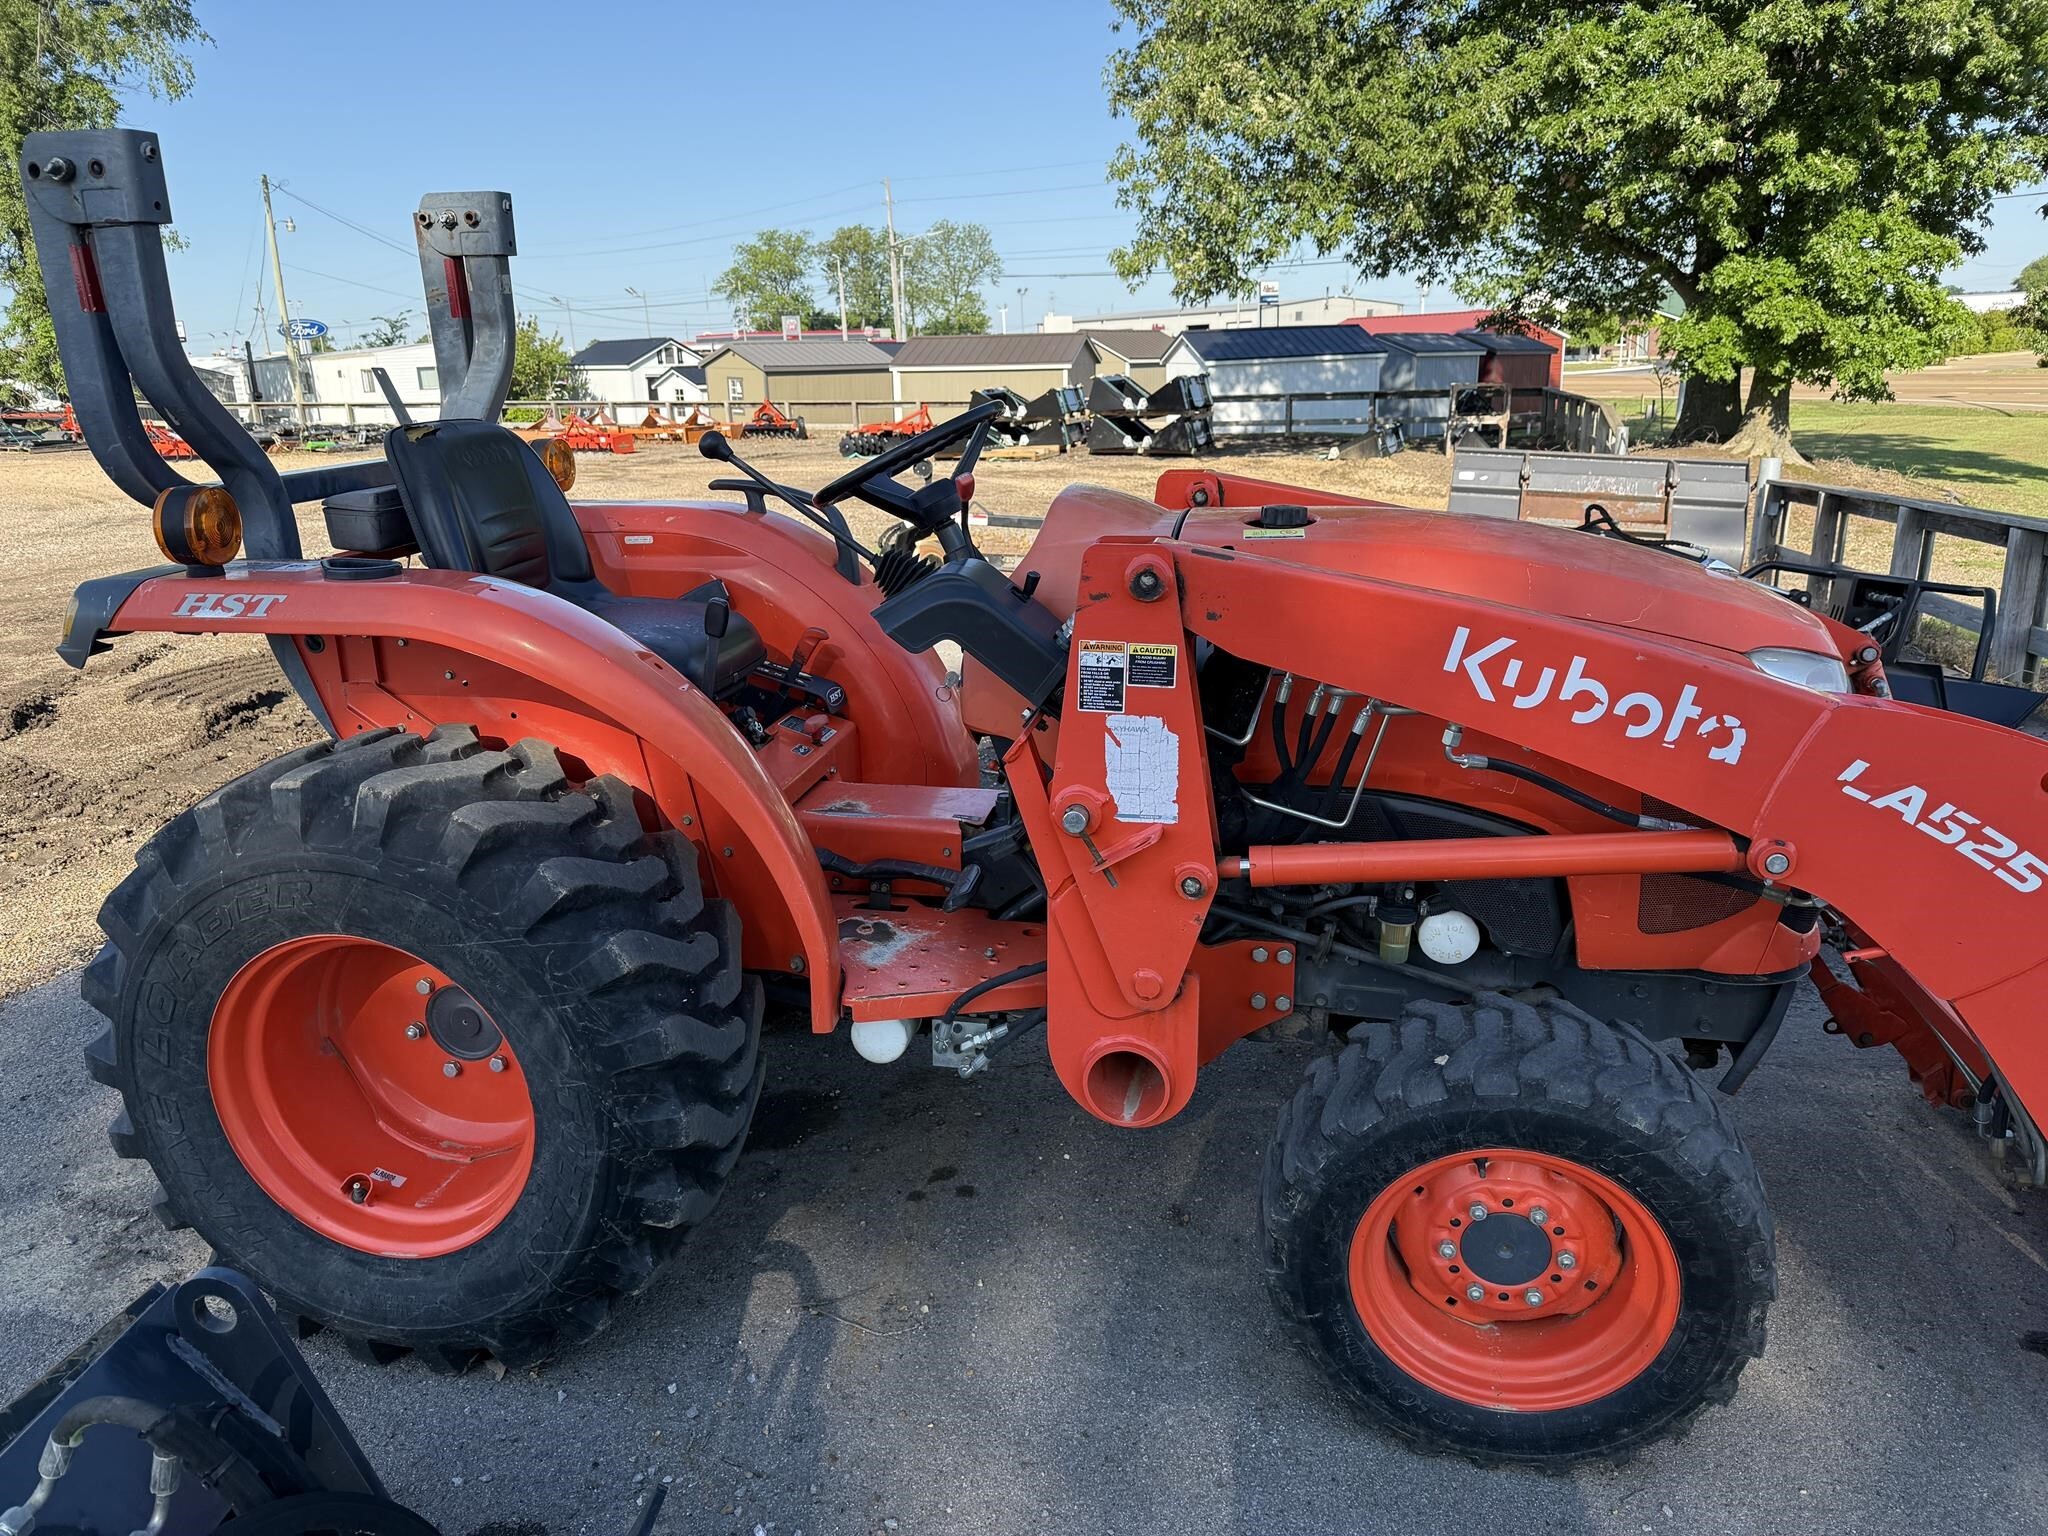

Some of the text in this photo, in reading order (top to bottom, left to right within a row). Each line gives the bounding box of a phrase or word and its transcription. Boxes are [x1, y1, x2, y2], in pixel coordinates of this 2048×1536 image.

[291, 322, 319, 336] Ford
[171, 593, 288, 618] HST
[1140, 647, 1173, 655] CAUTION
[829, 689, 842, 703] HST
[1443, 626, 1747, 765] Kubota
[1110, 726, 1150, 734] KYHAWK
[1836, 759, 2048, 892] LA525
[142, 880, 315, 1068] LOADER
